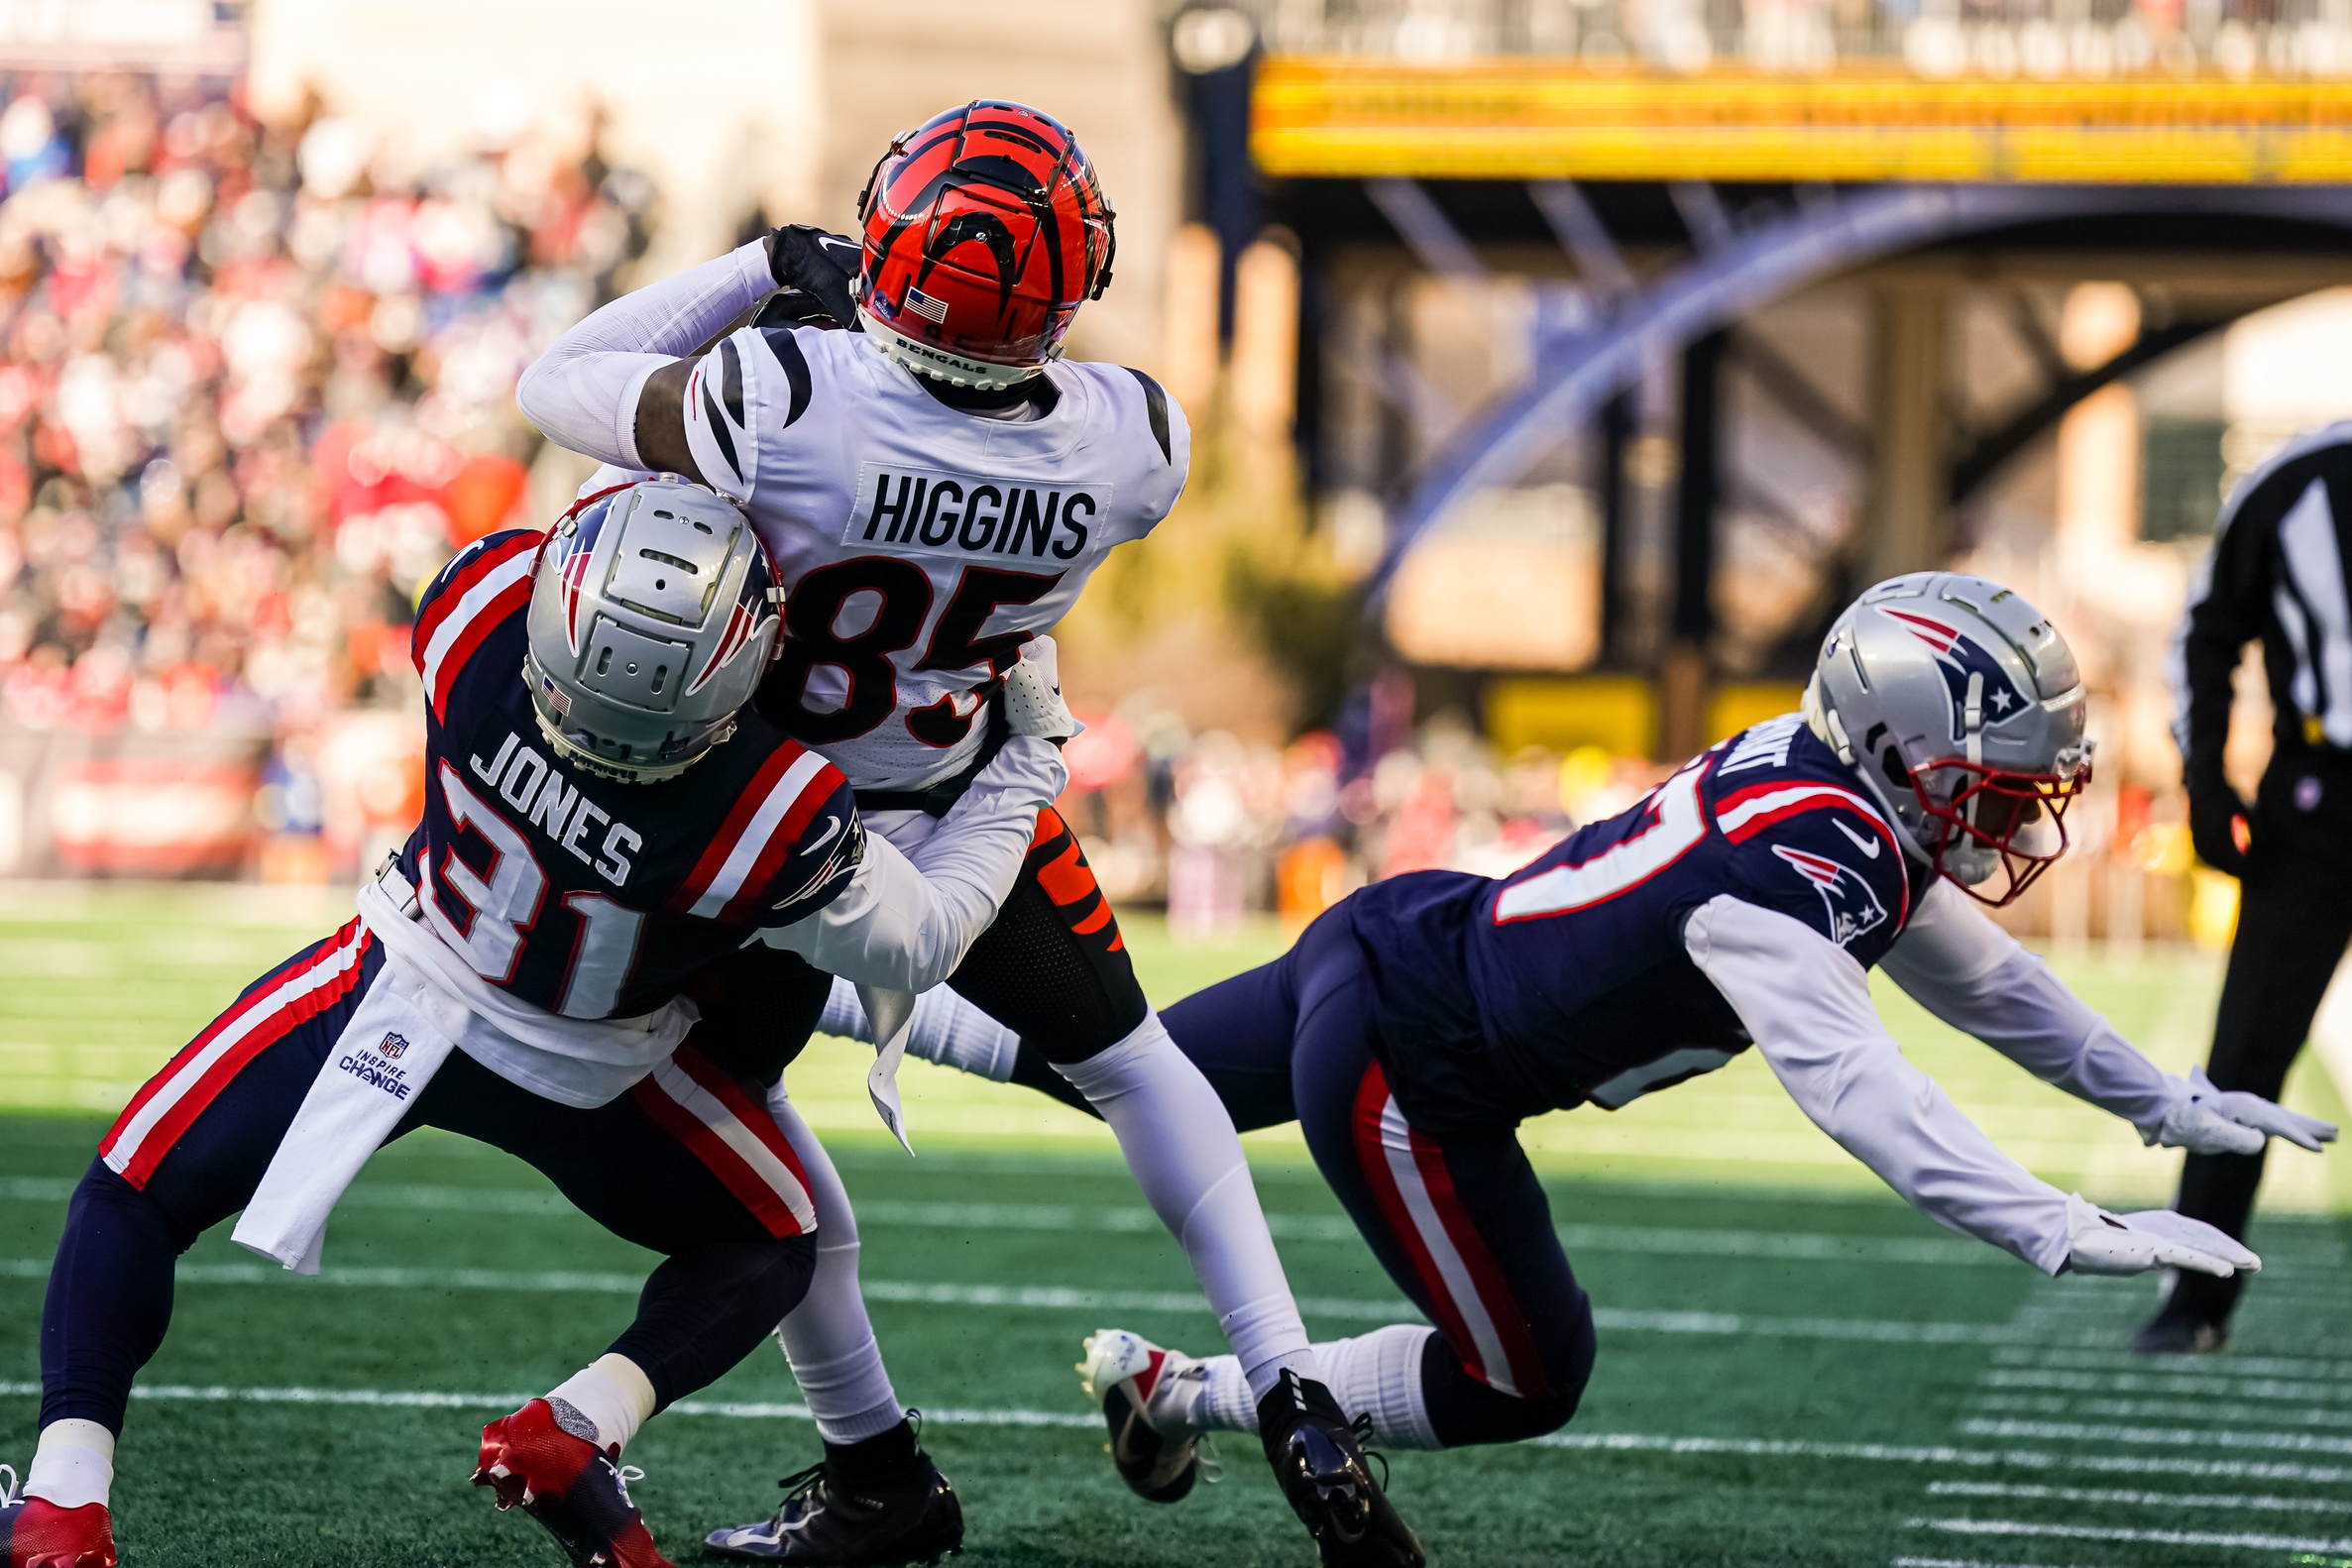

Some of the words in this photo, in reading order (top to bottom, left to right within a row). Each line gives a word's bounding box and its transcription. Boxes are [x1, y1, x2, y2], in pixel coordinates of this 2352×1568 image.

[895, 337, 987, 375] BENGALS
[862, 474, 1096, 560] HIGGINS
[757, 555, 1071, 748] 85
[470, 731, 642, 886] JONES
[1493, 736, 1735, 927] 7
[415, 756, 649, 1020] 31
[339, 1056, 411, 1101] CHANGE
[356, 1049, 407, 1080] INSPIRE
[381, 1040, 400, 1059] NFL
